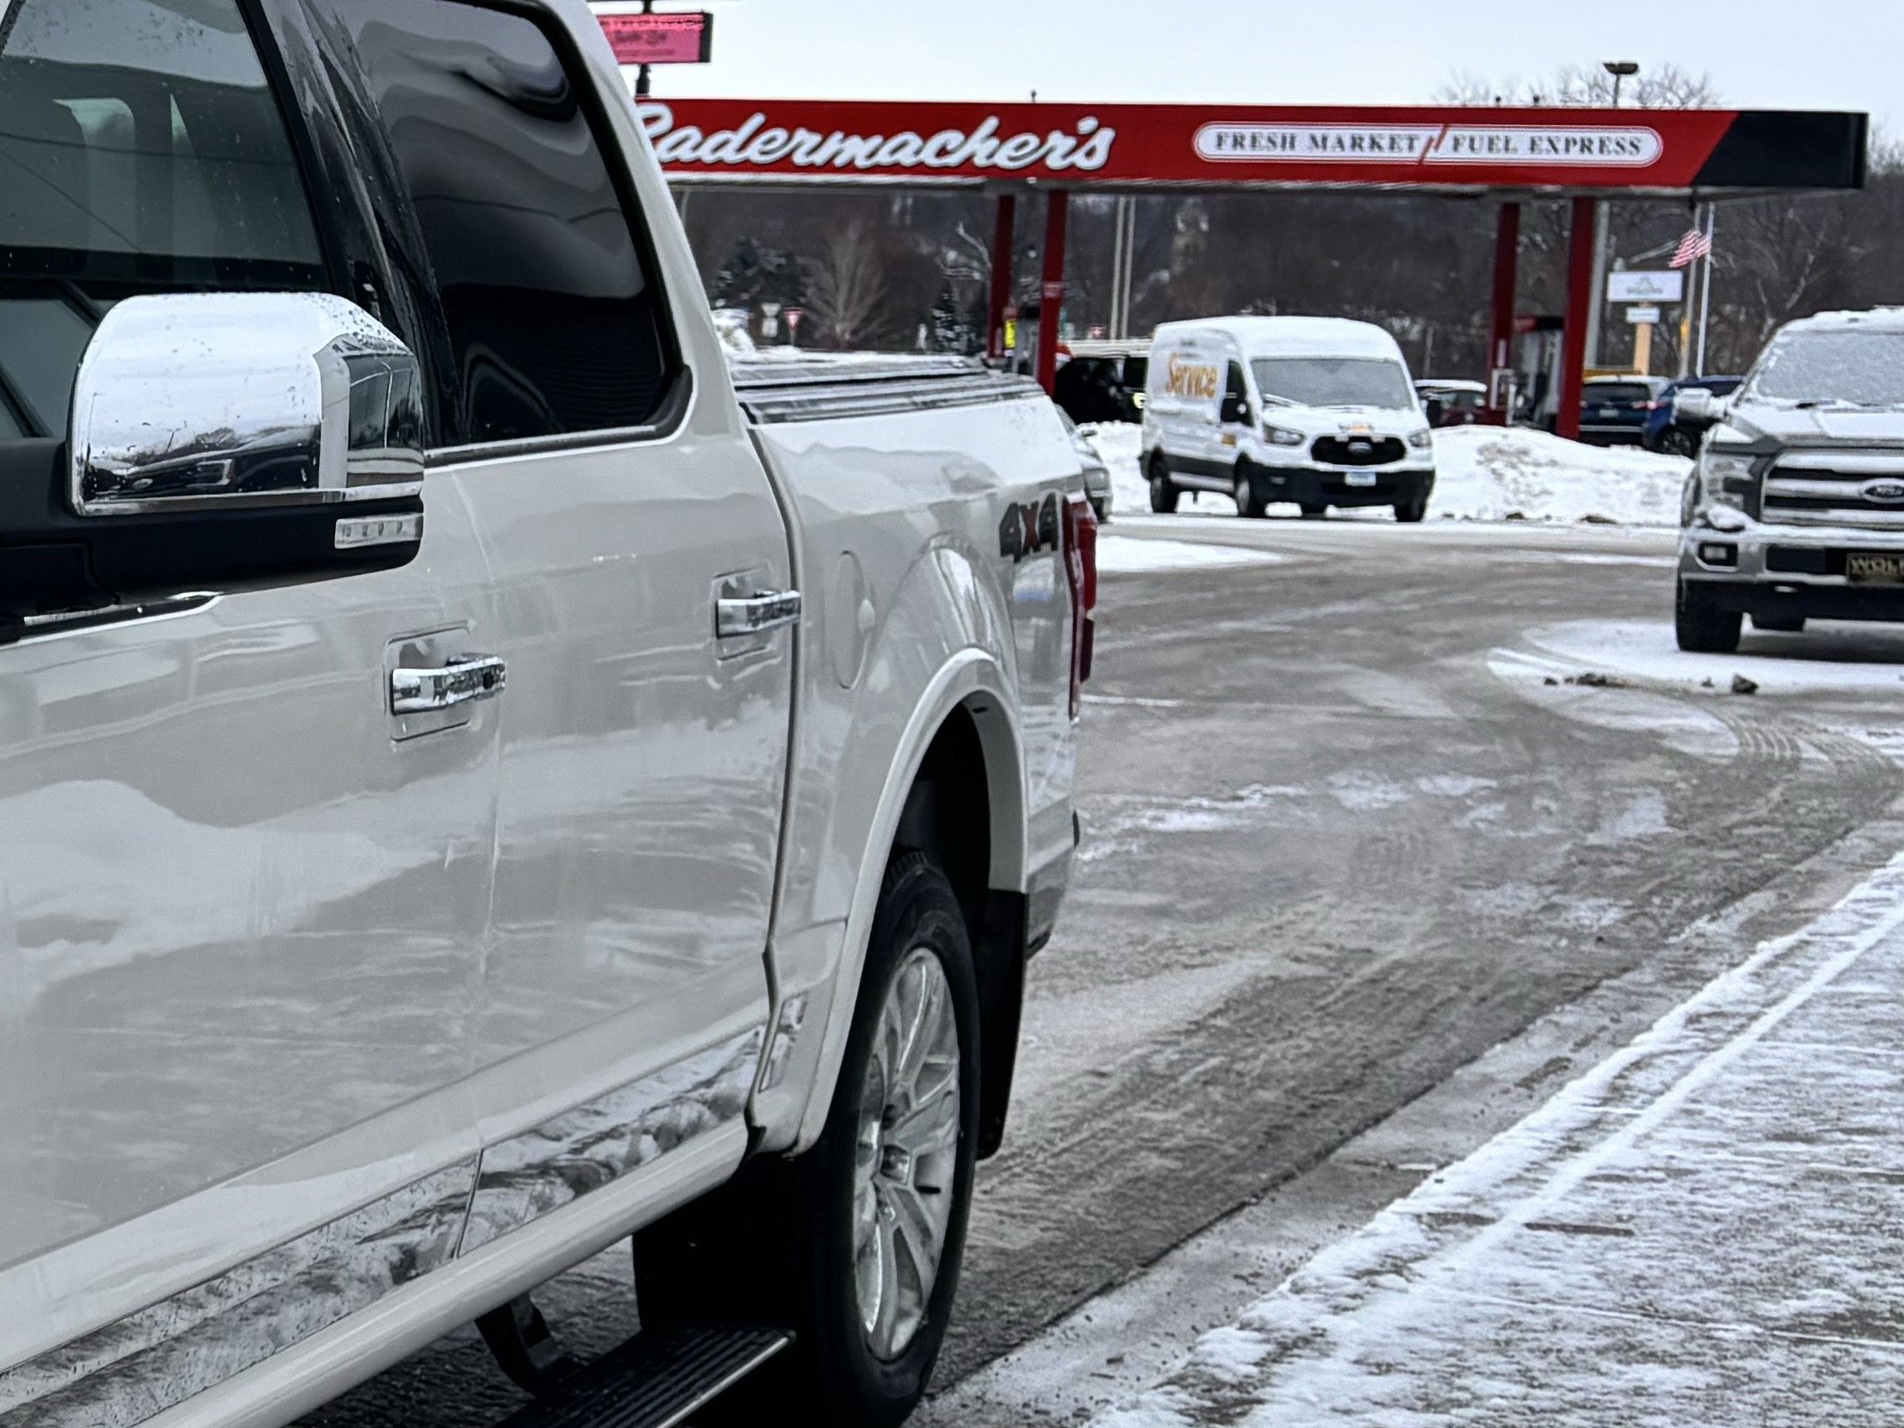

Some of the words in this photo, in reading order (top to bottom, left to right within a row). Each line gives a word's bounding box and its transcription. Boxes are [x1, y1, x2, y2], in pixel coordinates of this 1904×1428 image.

[1214, 132, 1296, 152] FRESH
[1309, 133, 1421, 154] MARKET
[1452, 134, 1519, 155] FUEL
[1528, 136, 1643, 157] EXPRESS
[1851, 558, 1904, 575] WOL
